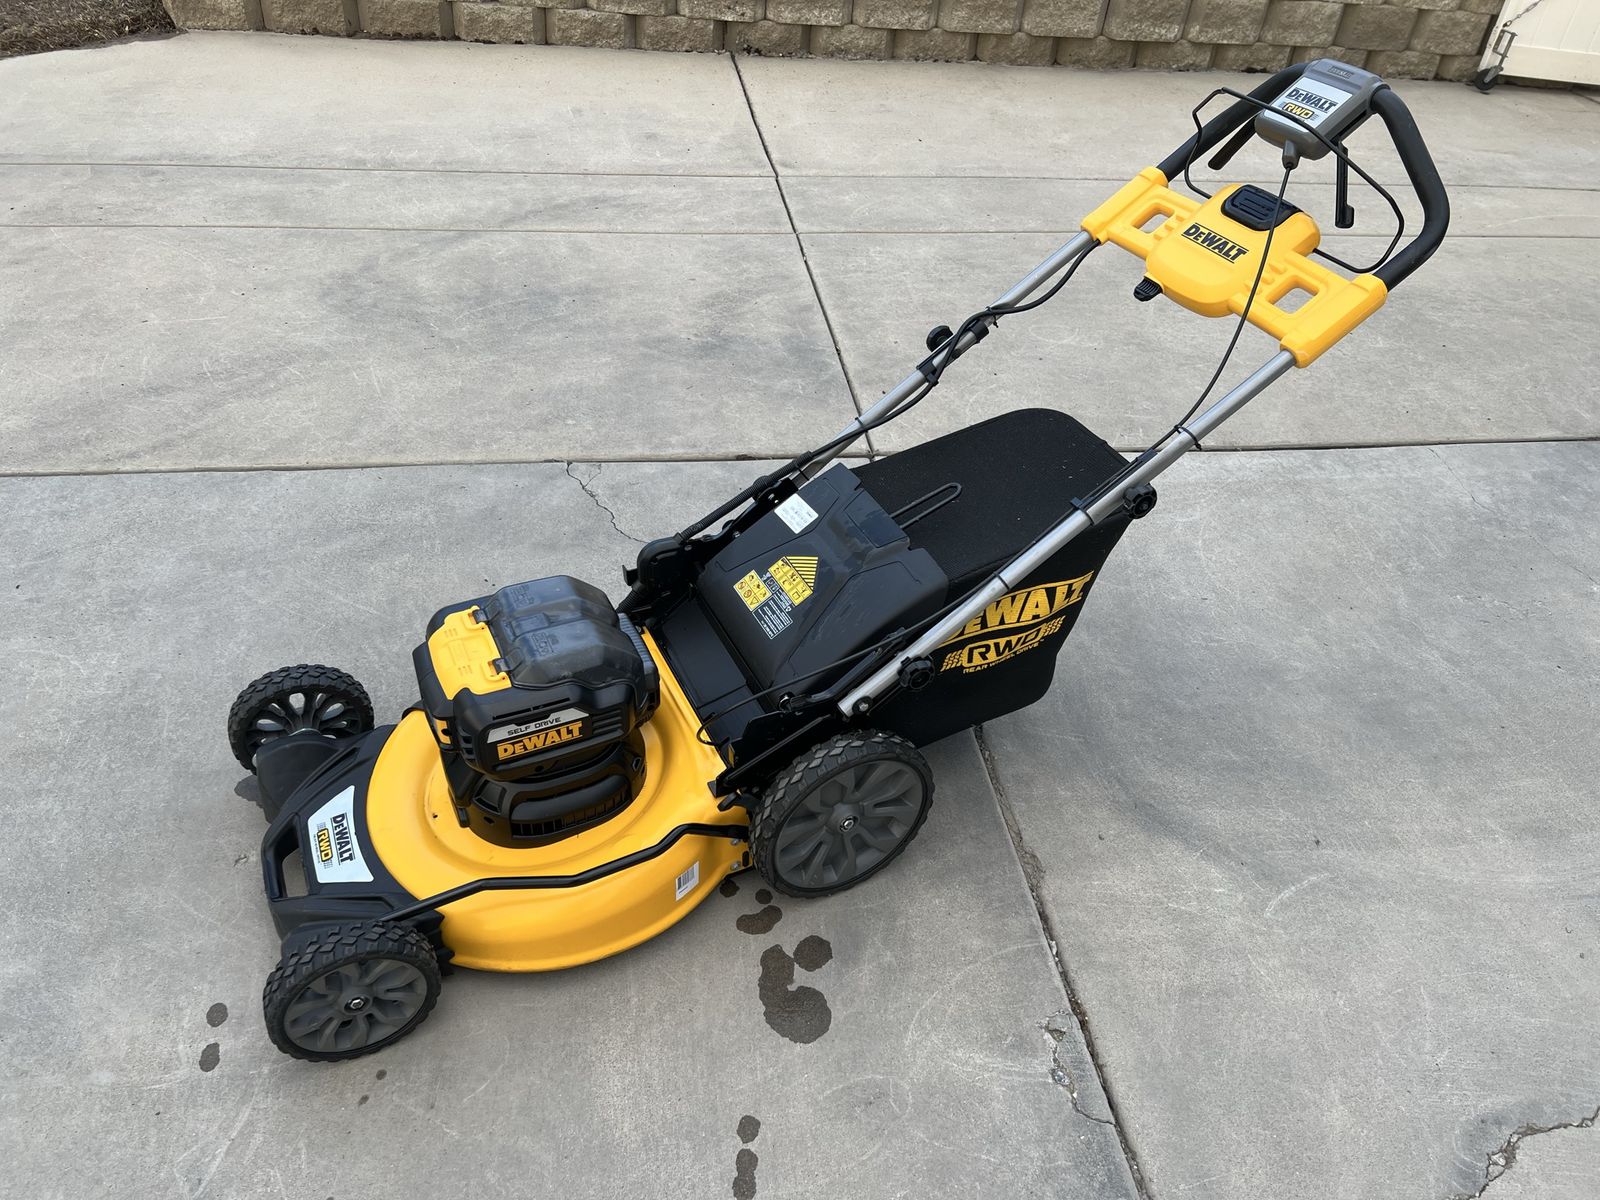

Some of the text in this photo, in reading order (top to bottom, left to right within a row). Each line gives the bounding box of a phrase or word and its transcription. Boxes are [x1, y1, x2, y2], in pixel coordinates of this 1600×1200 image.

[1284, 102, 1313, 119] RWD
[1285, 88, 1337, 112] DEWALT
[1182, 223, 1248, 262] DEWALT
[942, 573, 1093, 641] EWALT
[967, 623, 1042, 664] RWD
[497, 721, 583, 760] DEWALT
[507, 717, 561, 736] SELF DRIVE
[317, 828, 332, 862] RWD
[332, 812, 354, 863] DEWALT
